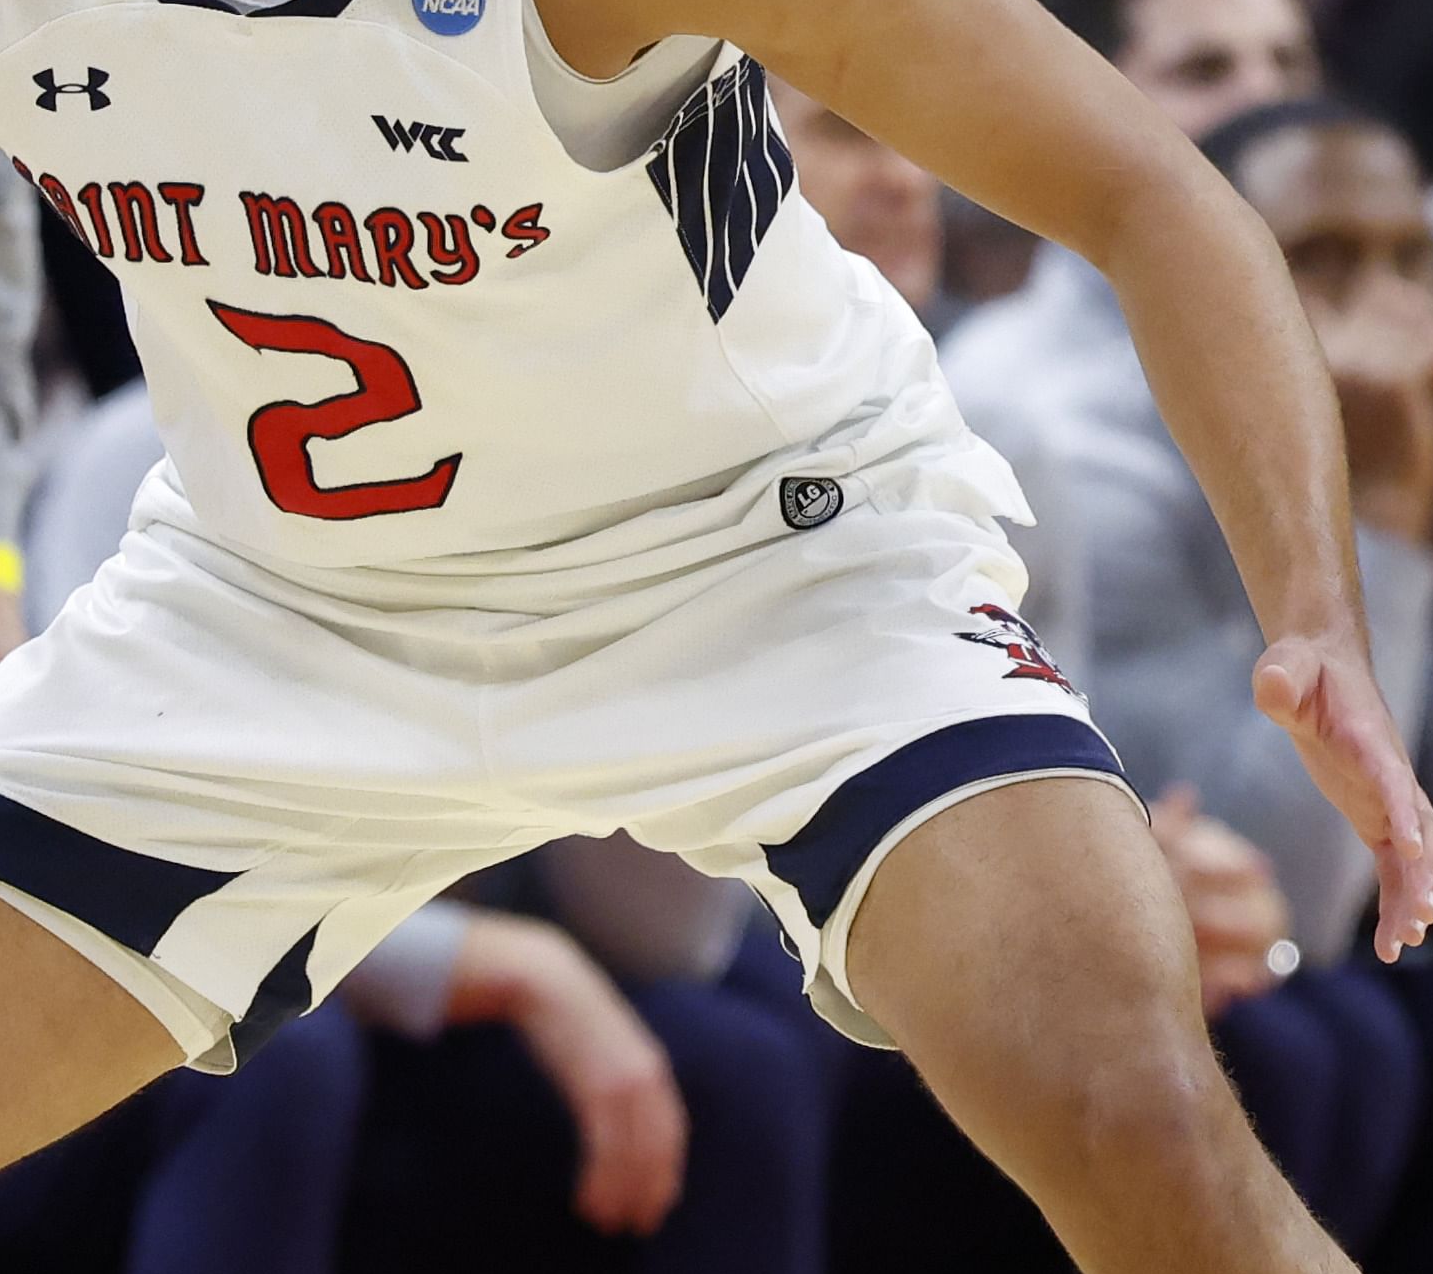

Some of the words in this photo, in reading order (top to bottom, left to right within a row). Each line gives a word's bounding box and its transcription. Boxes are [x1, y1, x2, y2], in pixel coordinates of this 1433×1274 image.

[371, 114, 470, 163] WCC
[238, 190, 552, 291] MARY'S
[206, 297, 464, 521] 2
